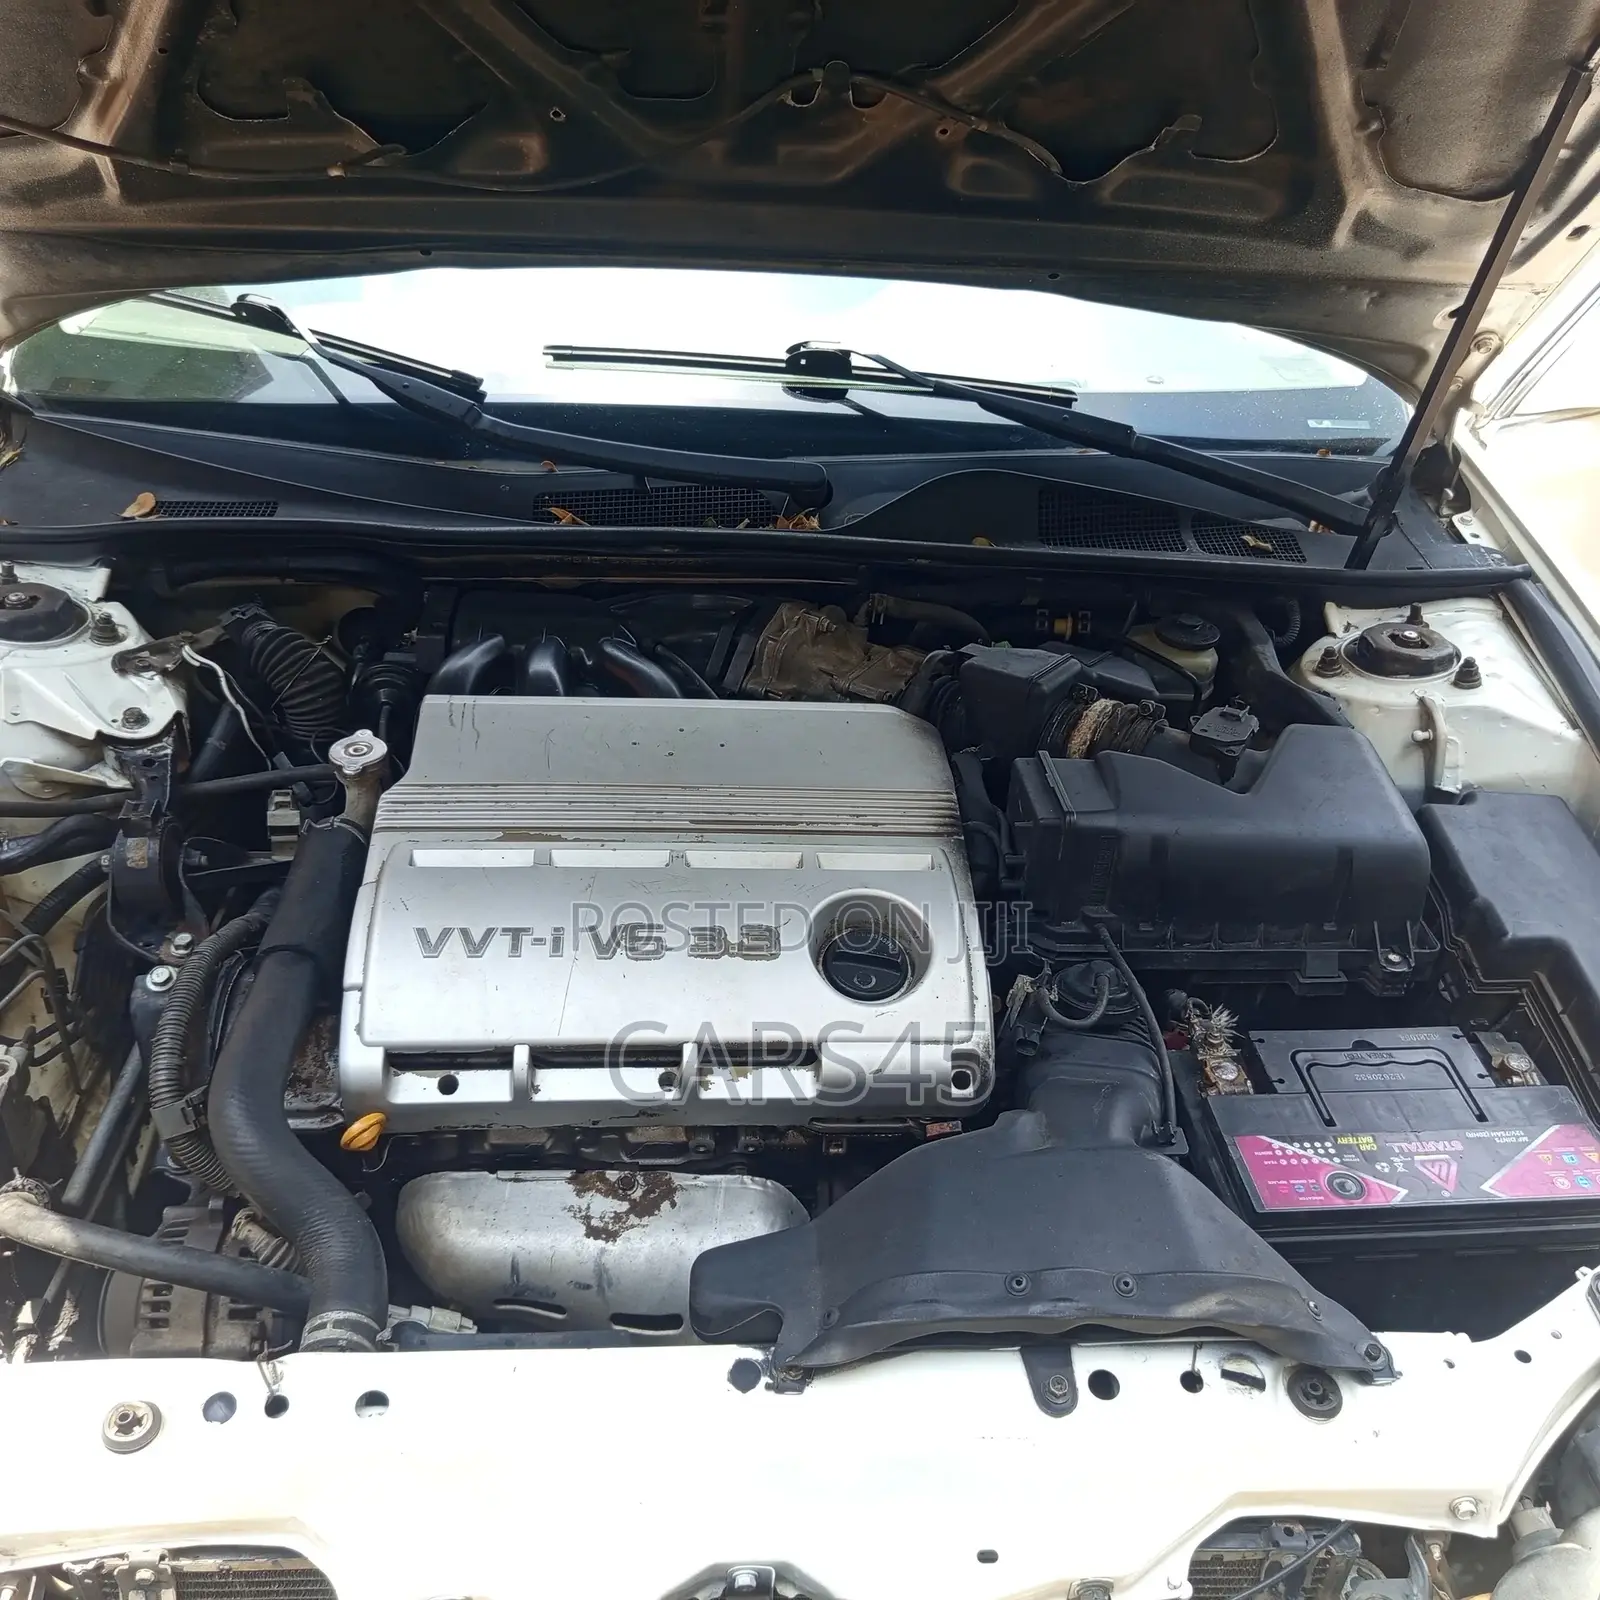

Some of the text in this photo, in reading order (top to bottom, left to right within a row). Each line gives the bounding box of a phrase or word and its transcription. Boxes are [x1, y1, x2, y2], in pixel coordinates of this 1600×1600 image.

[413, 922, 781, 961] VVT-i V6 3.3
[1337, 1136, 1375, 1145] BATTERY
[1359, 1143, 1377, 1151] CAR
